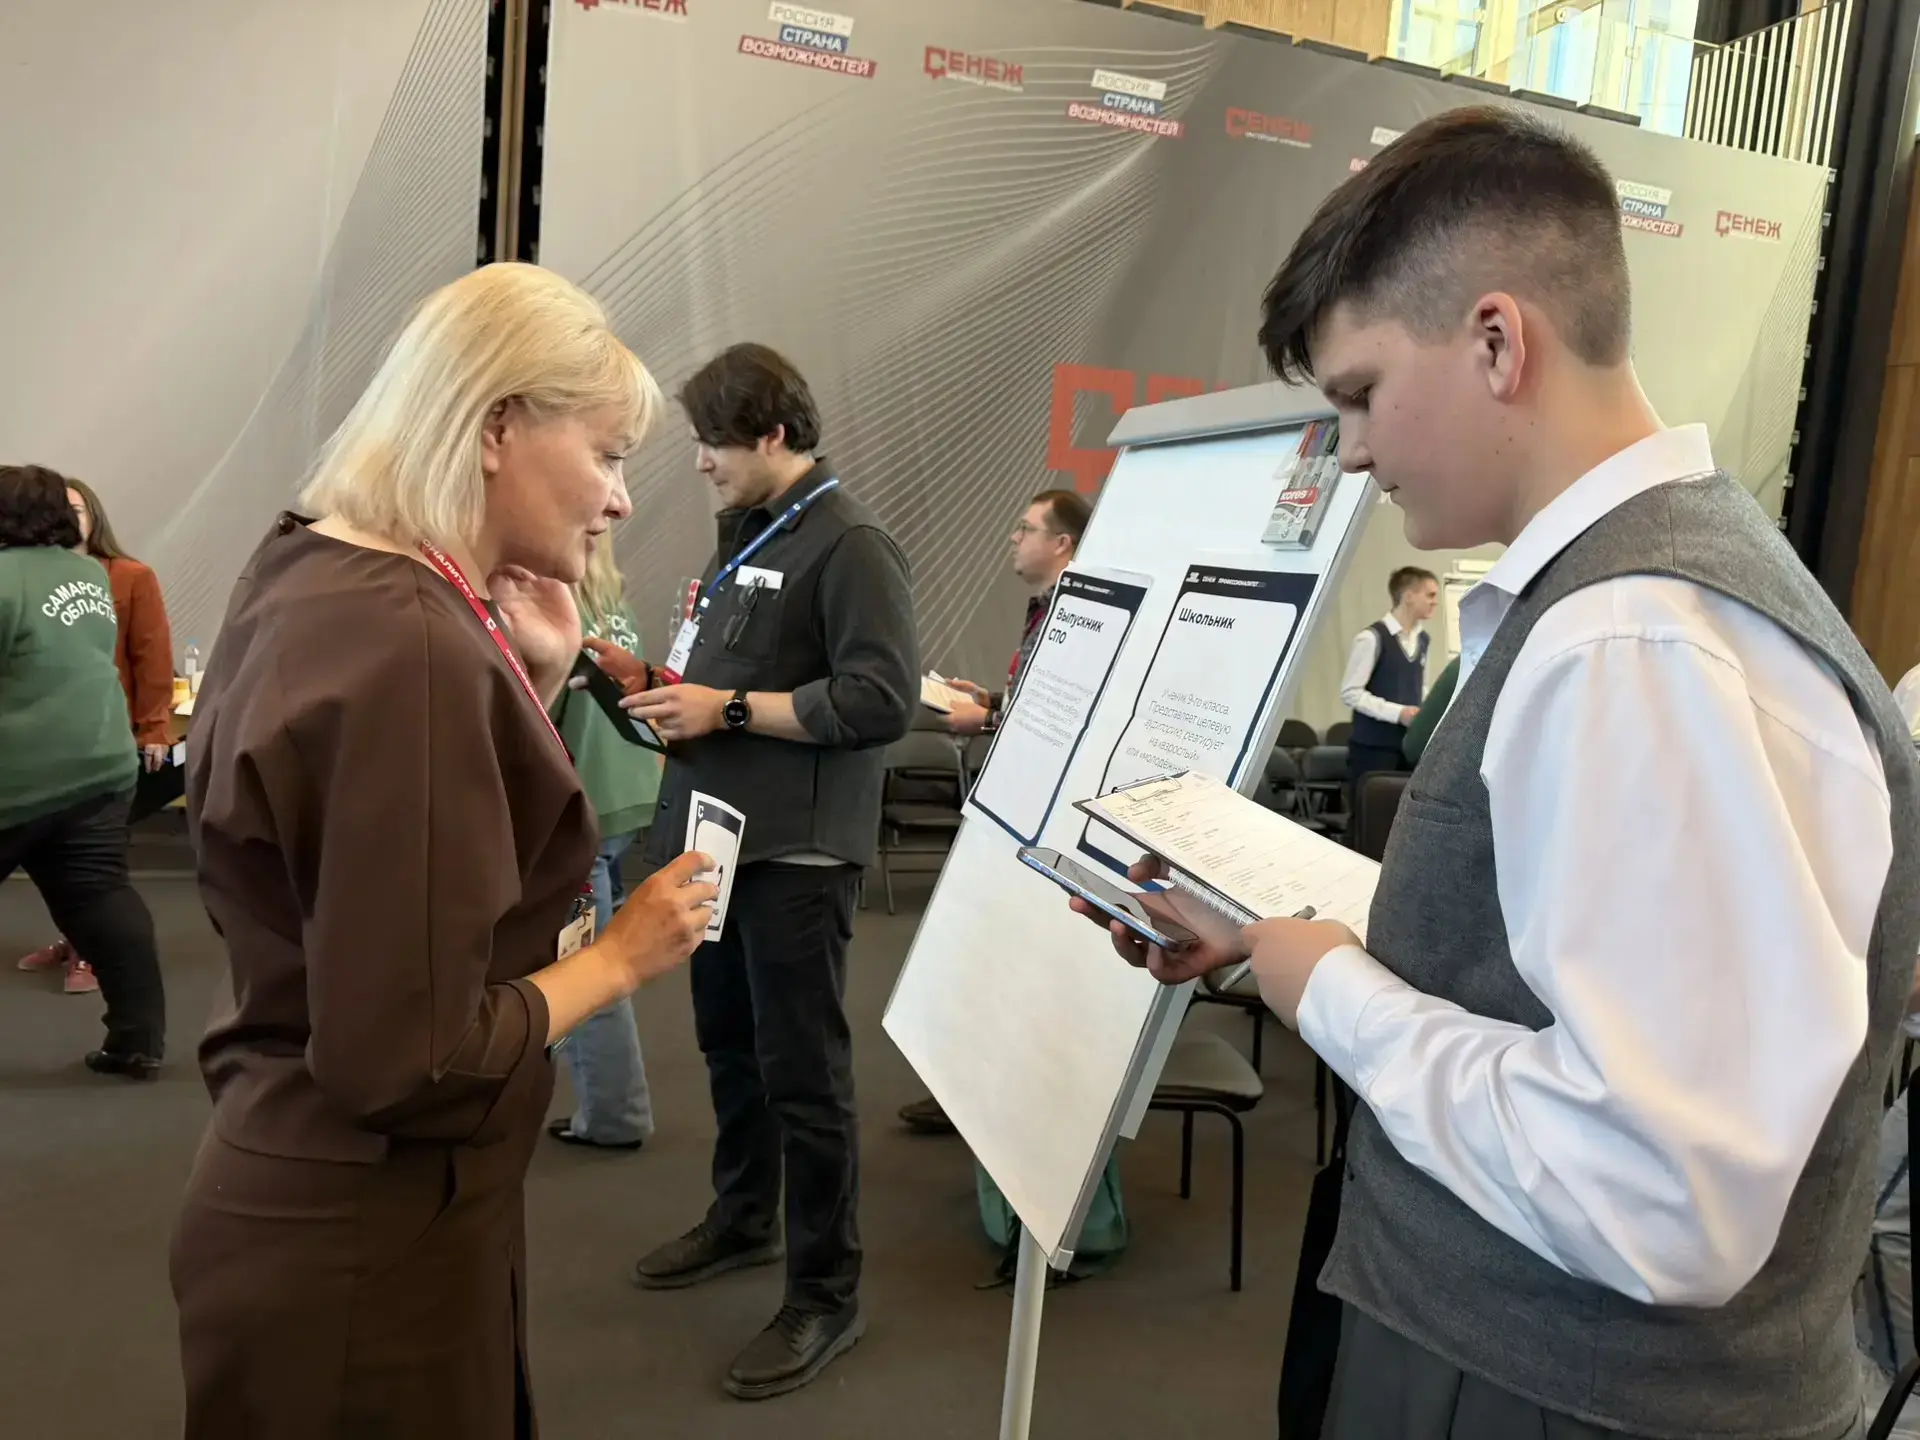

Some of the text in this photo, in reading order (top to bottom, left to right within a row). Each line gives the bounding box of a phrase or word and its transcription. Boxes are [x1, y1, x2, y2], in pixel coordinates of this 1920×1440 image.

[773, 6, 835, 29] РОССИЯ
[781, 27, 843, 52] СТРАНА
[741, 37, 871, 76] ВОЗМОЖНОСТЕЙ
[924, 45, 1024, 86] СЕНЕЖ
[1103, 91, 1156, 115] СТРАНА
[1068, 102, 1180, 136] ВОЗМОЖНОСТЕЙ
[1622, 199, 1662, 218] СТРАНА
[1620, 214, 1680, 236] ОЖНОСТЕЙ
[1715, 210, 1783, 241] СЕНЕЖ
[41, 580, 114, 618] САМАРСКА
[1056, 607, 1104, 633] Выпускник
[1178, 607, 1236, 630] Школьник
[1048, 628, 1067, 644] СПО
[1148, 700, 1232, 735] Представляет целевую
[1182, 731, 1225, 751] реагирует
